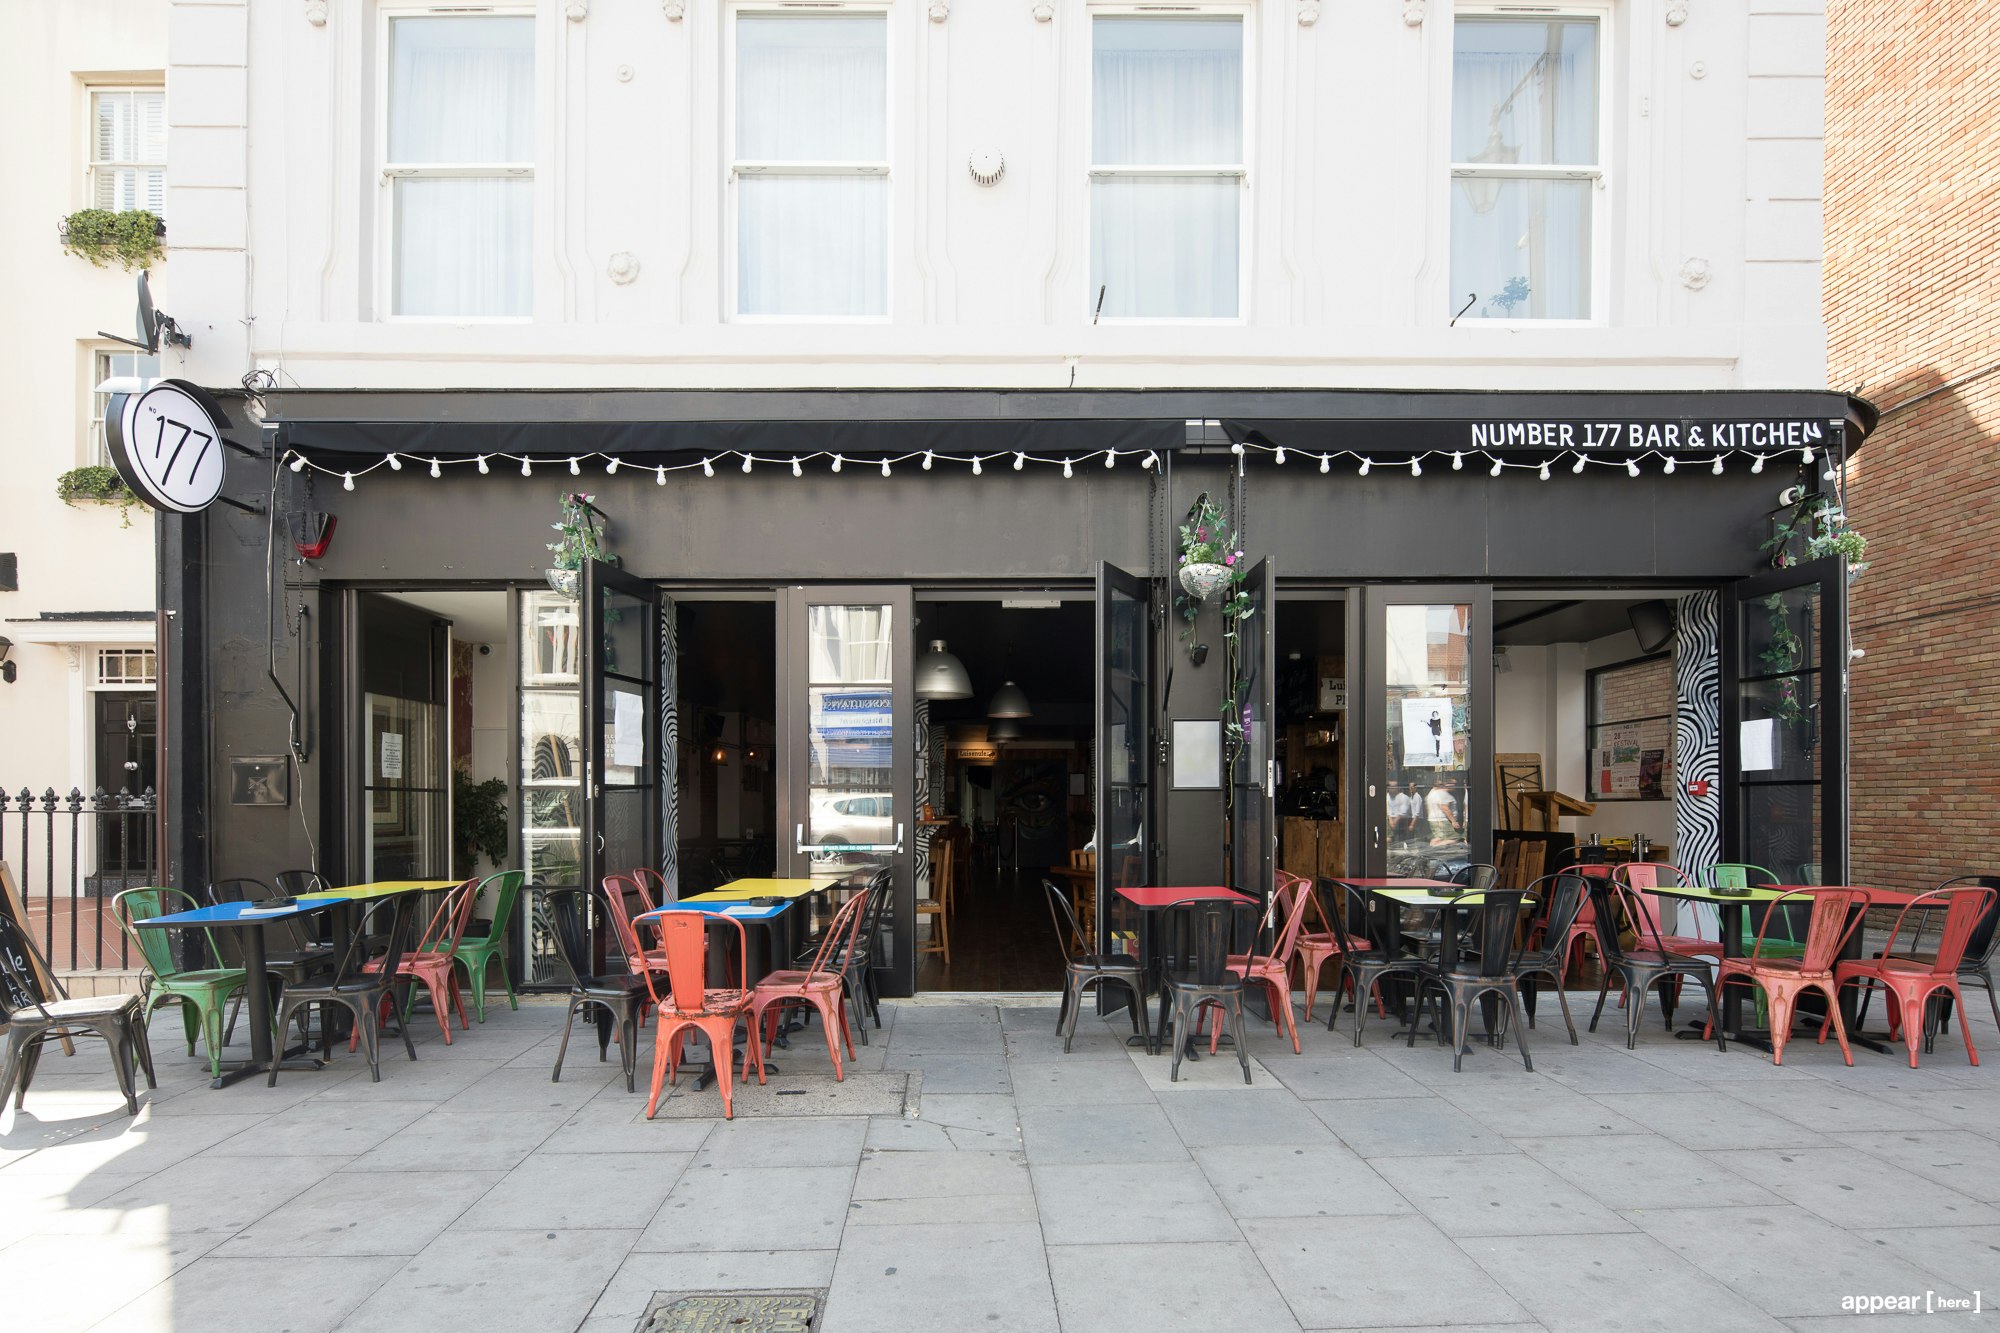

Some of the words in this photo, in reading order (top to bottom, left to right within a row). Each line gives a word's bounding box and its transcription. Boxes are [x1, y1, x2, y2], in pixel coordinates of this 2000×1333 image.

[156, 415, 213, 486] 177
[1471, 423, 1575, 447] NUMBER
[1582, 424, 1622, 447] 177
[1629, 424, 1681, 447] BAR
[1687, 424, 1705, 447] &
[1712, 422, 1822, 447] KITCHEN
